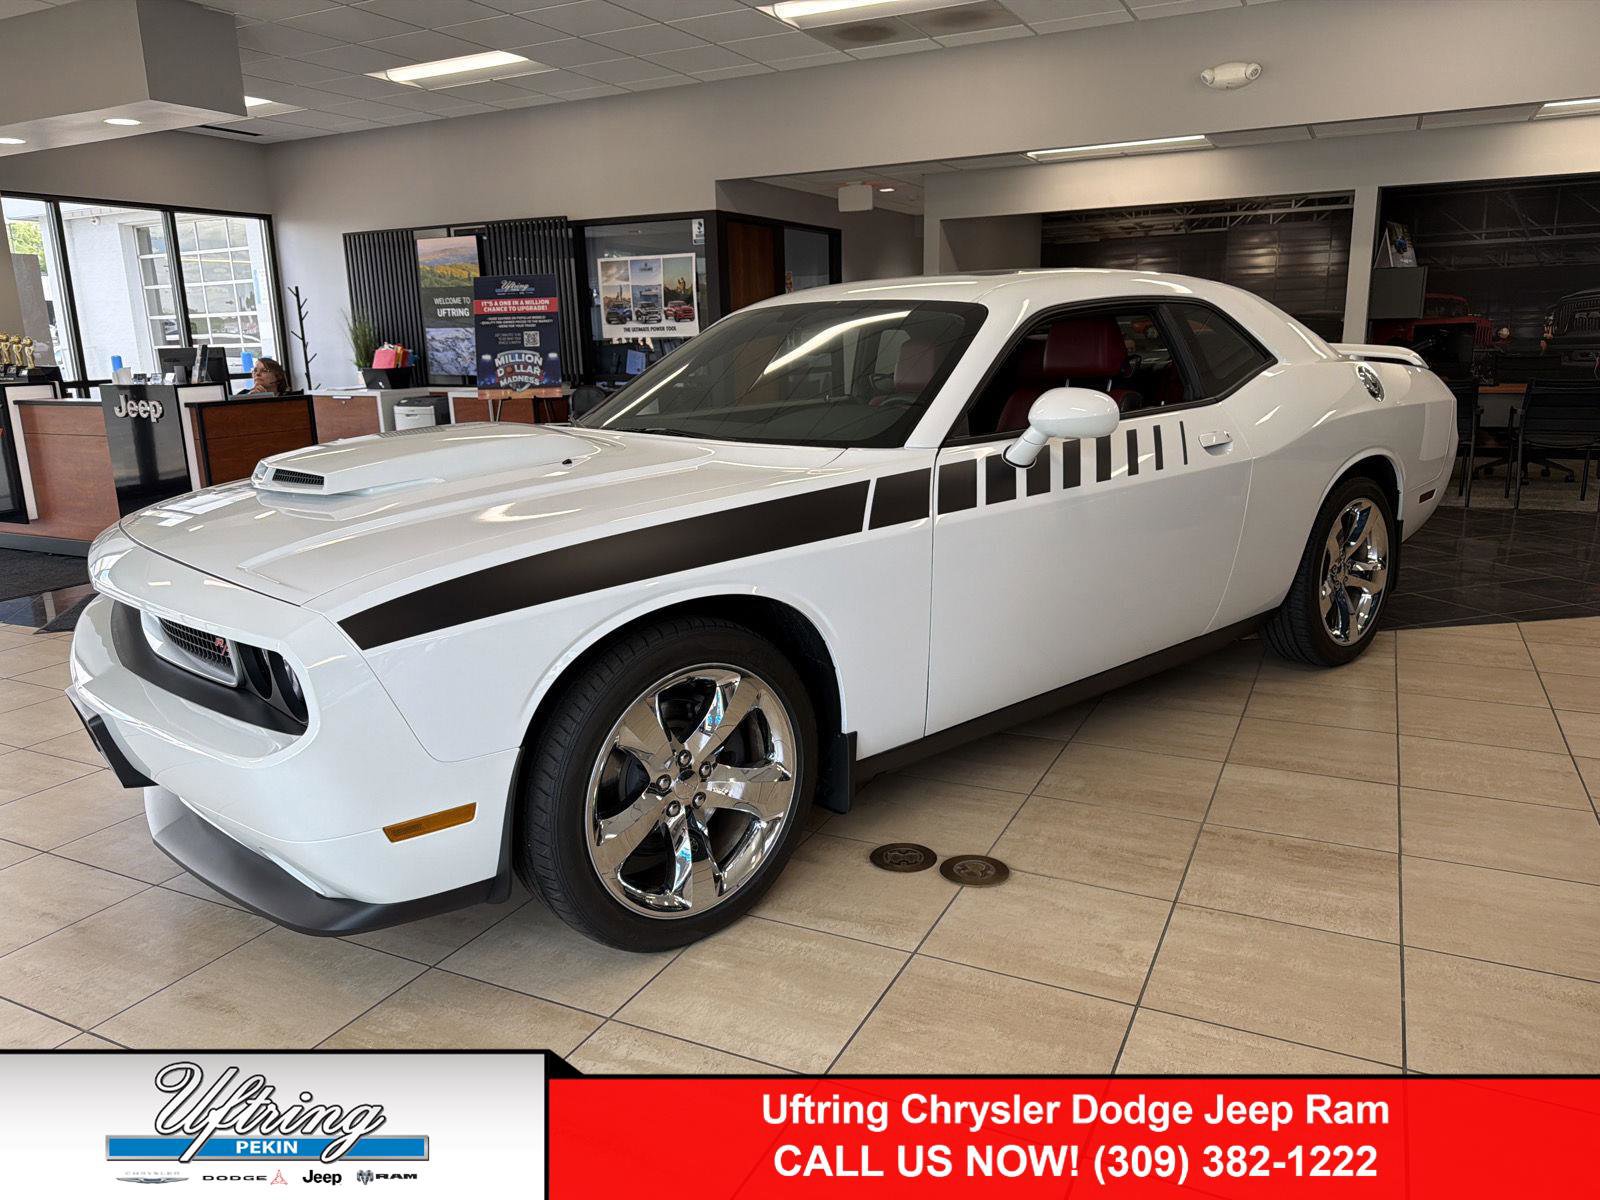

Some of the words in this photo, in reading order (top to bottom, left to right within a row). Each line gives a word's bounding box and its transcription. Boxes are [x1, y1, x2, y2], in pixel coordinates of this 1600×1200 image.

[433, 297, 462, 305] WELCOME
[462, 296, 471, 304] TO
[436, 307, 470, 317] UFTRING
[495, 353, 543, 367] MILLION
[499, 375, 540, 387] MADNESS
[114, 393, 163, 423] Jeep
